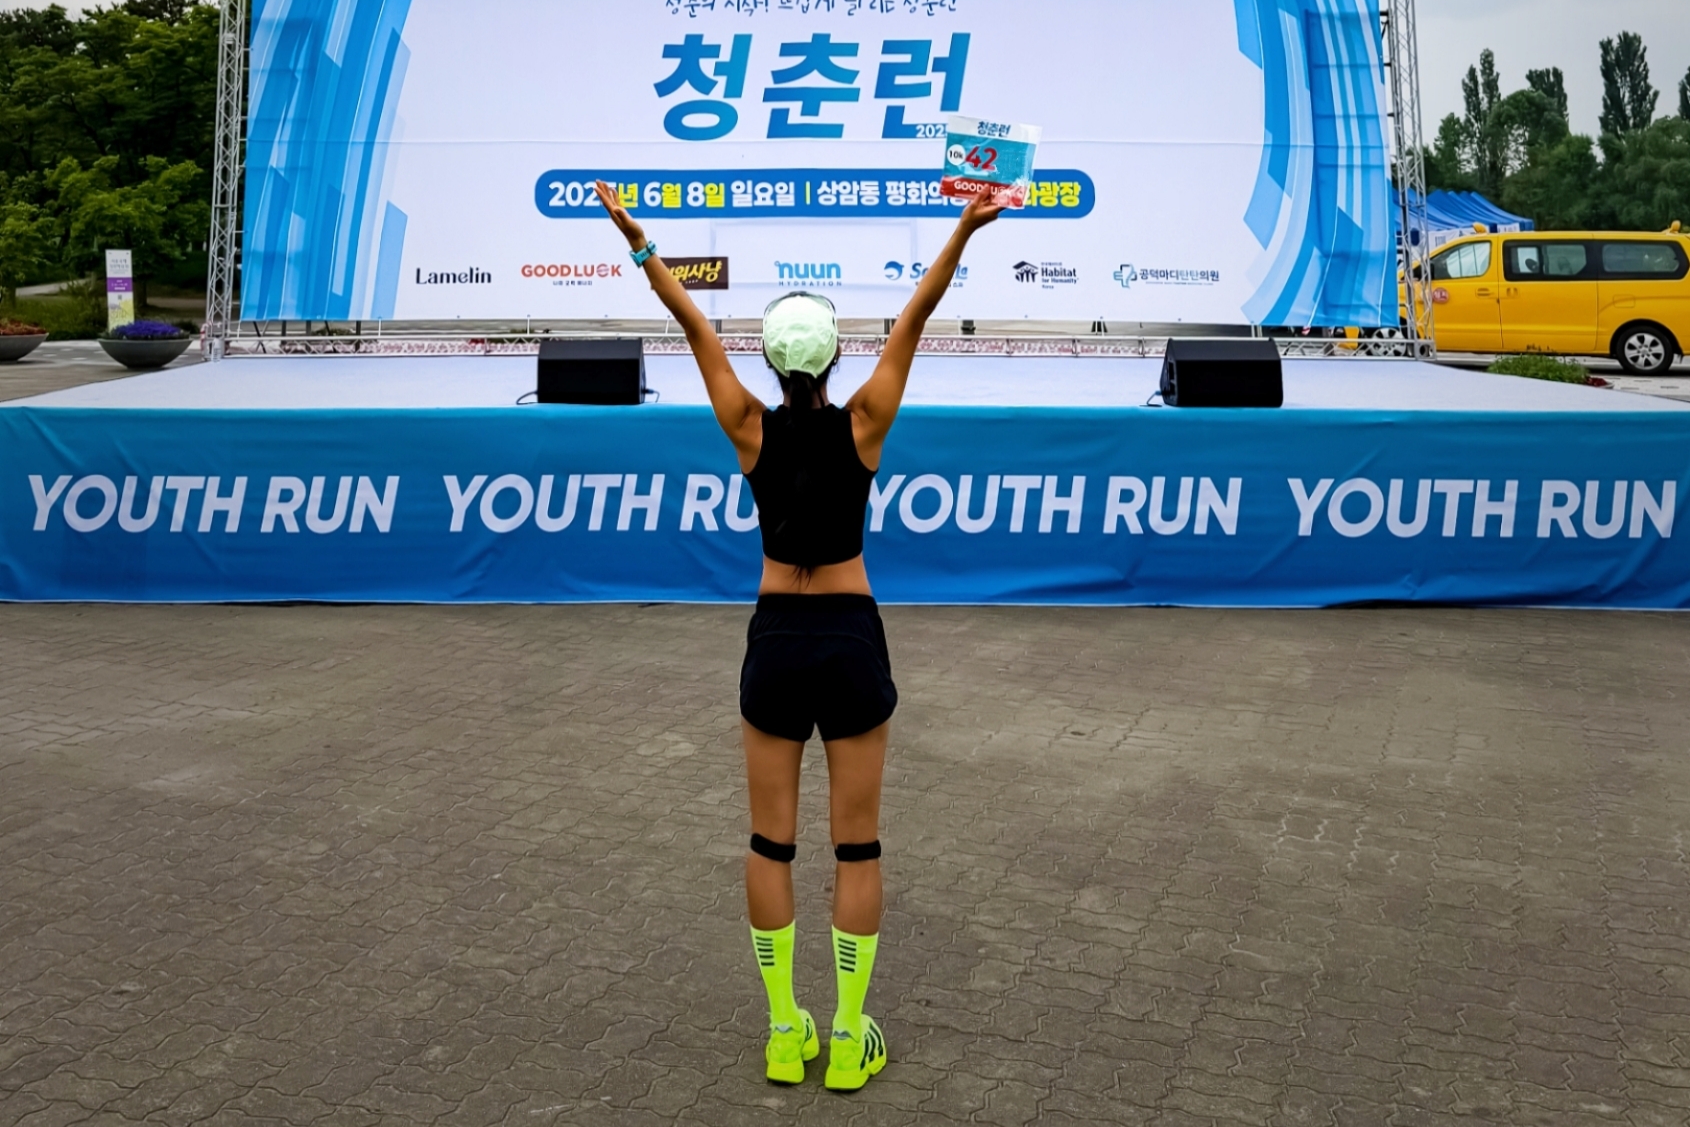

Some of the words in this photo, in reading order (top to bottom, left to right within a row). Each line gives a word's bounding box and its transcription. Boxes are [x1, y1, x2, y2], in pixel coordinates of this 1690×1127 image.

[653, 32, 971, 141] 청춘런
[916, 124, 948, 138] 202
[977, 120, 1011, 139] 청춘런
[965, 145, 998, 171] 42
[549, 180, 638, 208] 202년
[643, 181, 682, 208] 6월
[686, 181, 725, 208] 8일
[731, 180, 795, 207] 일요일
[817, 180, 880, 206] 상암동
[415, 266, 492, 285] Lamelin
[669, 260, 723, 283] 위사냥
[776, 261, 842, 279] nuun
[1041, 267, 1077, 277] Habitat
[28, 475, 248, 533] YOUTH
[260, 476, 400, 533] RUN
[443, 474, 666, 533] YOUTH
[680, 474, 759, 532] RU
[868, 474, 1085, 534] YOUTH
[1103, 476, 1242, 535] RUN
[1288, 478, 1519, 538] YOUTH
[1537, 480, 1677, 539] RUN
